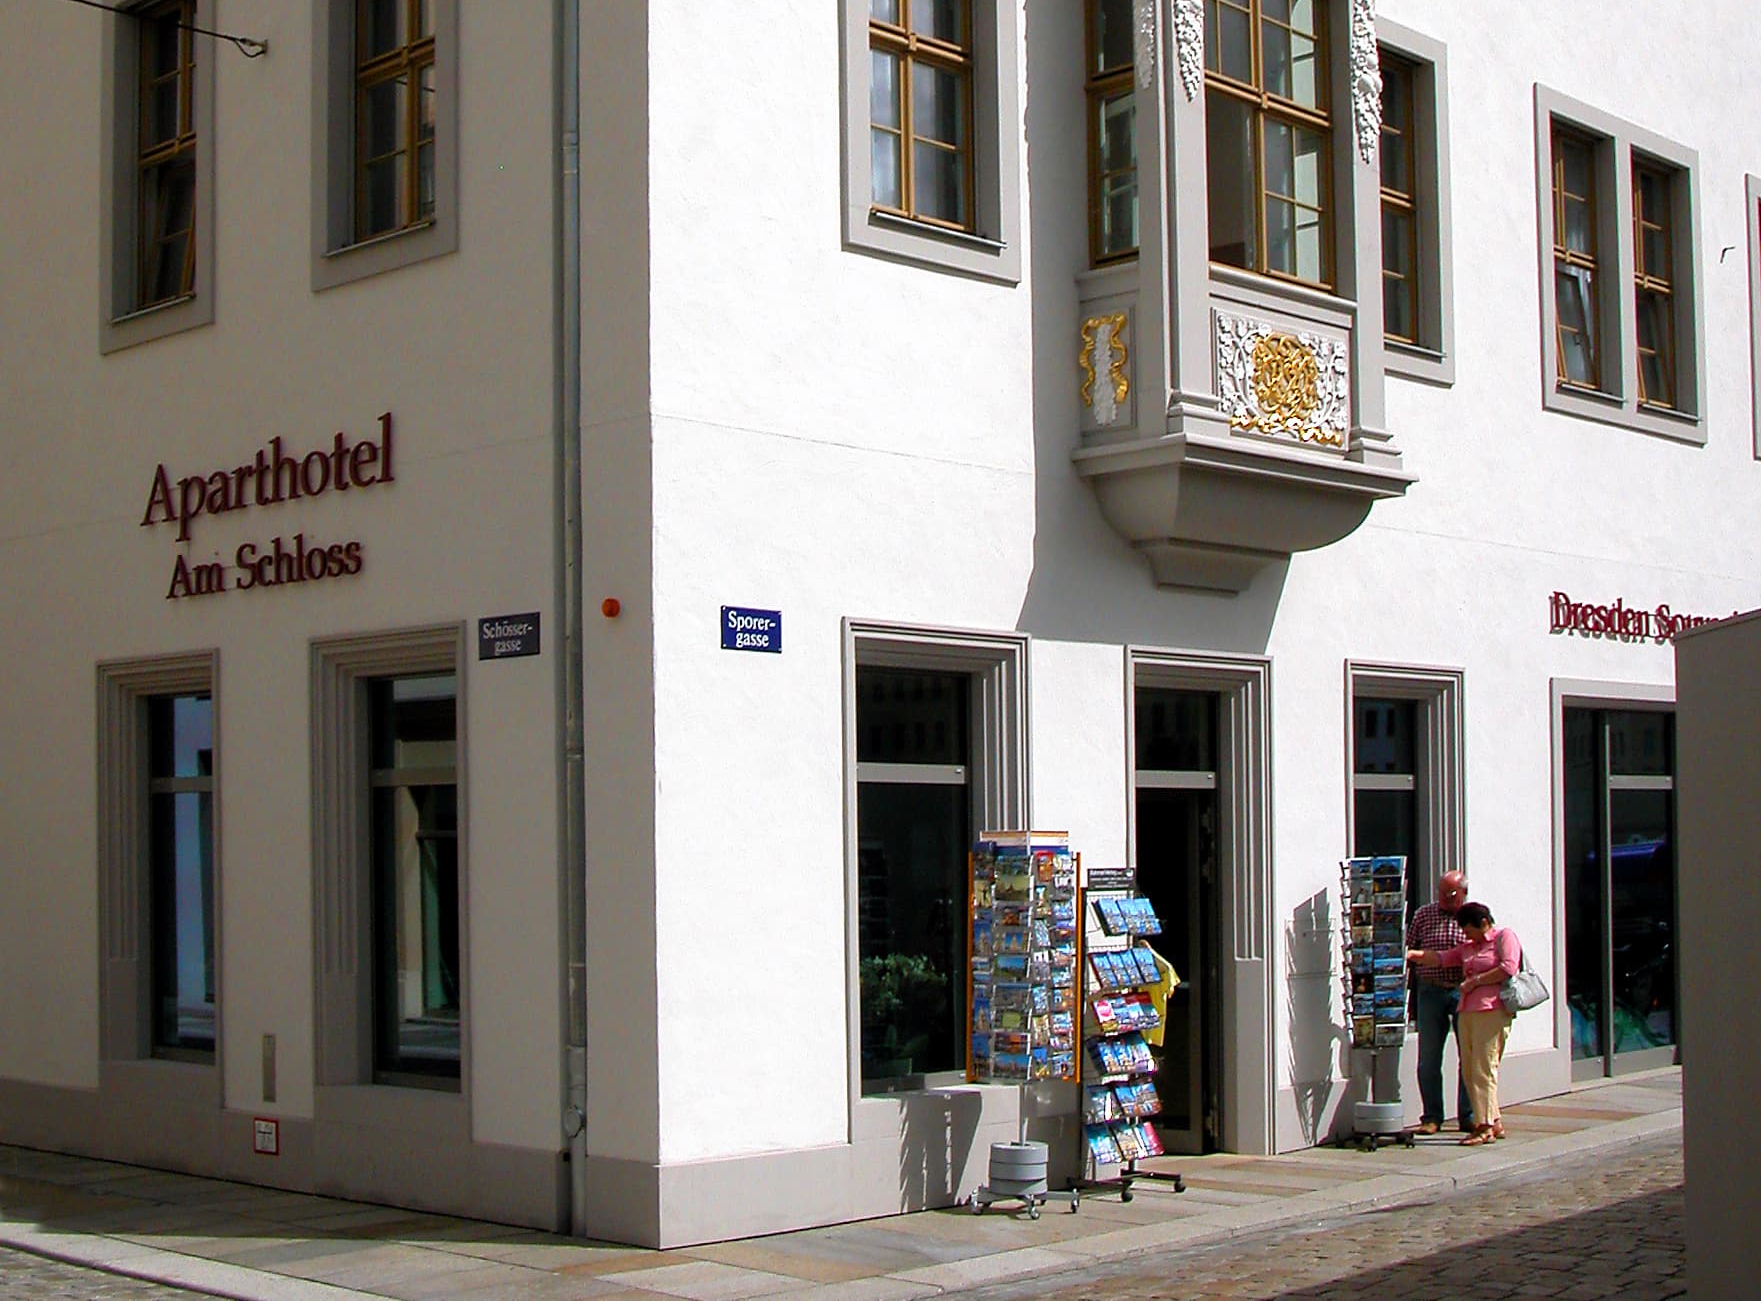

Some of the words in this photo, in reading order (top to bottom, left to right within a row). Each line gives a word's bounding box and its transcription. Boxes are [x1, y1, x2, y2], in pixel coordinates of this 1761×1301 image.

[140, 412, 396, 542] Aparthotel
[166, 555, 226, 600] Am
[236, 534, 363, 589] Schloss
[728, 610, 776, 631] Sporer-
[1550, 590, 1650, 637] Dresden
[495, 639, 521, 656] gasse
[735, 632, 769, 648] gasse
